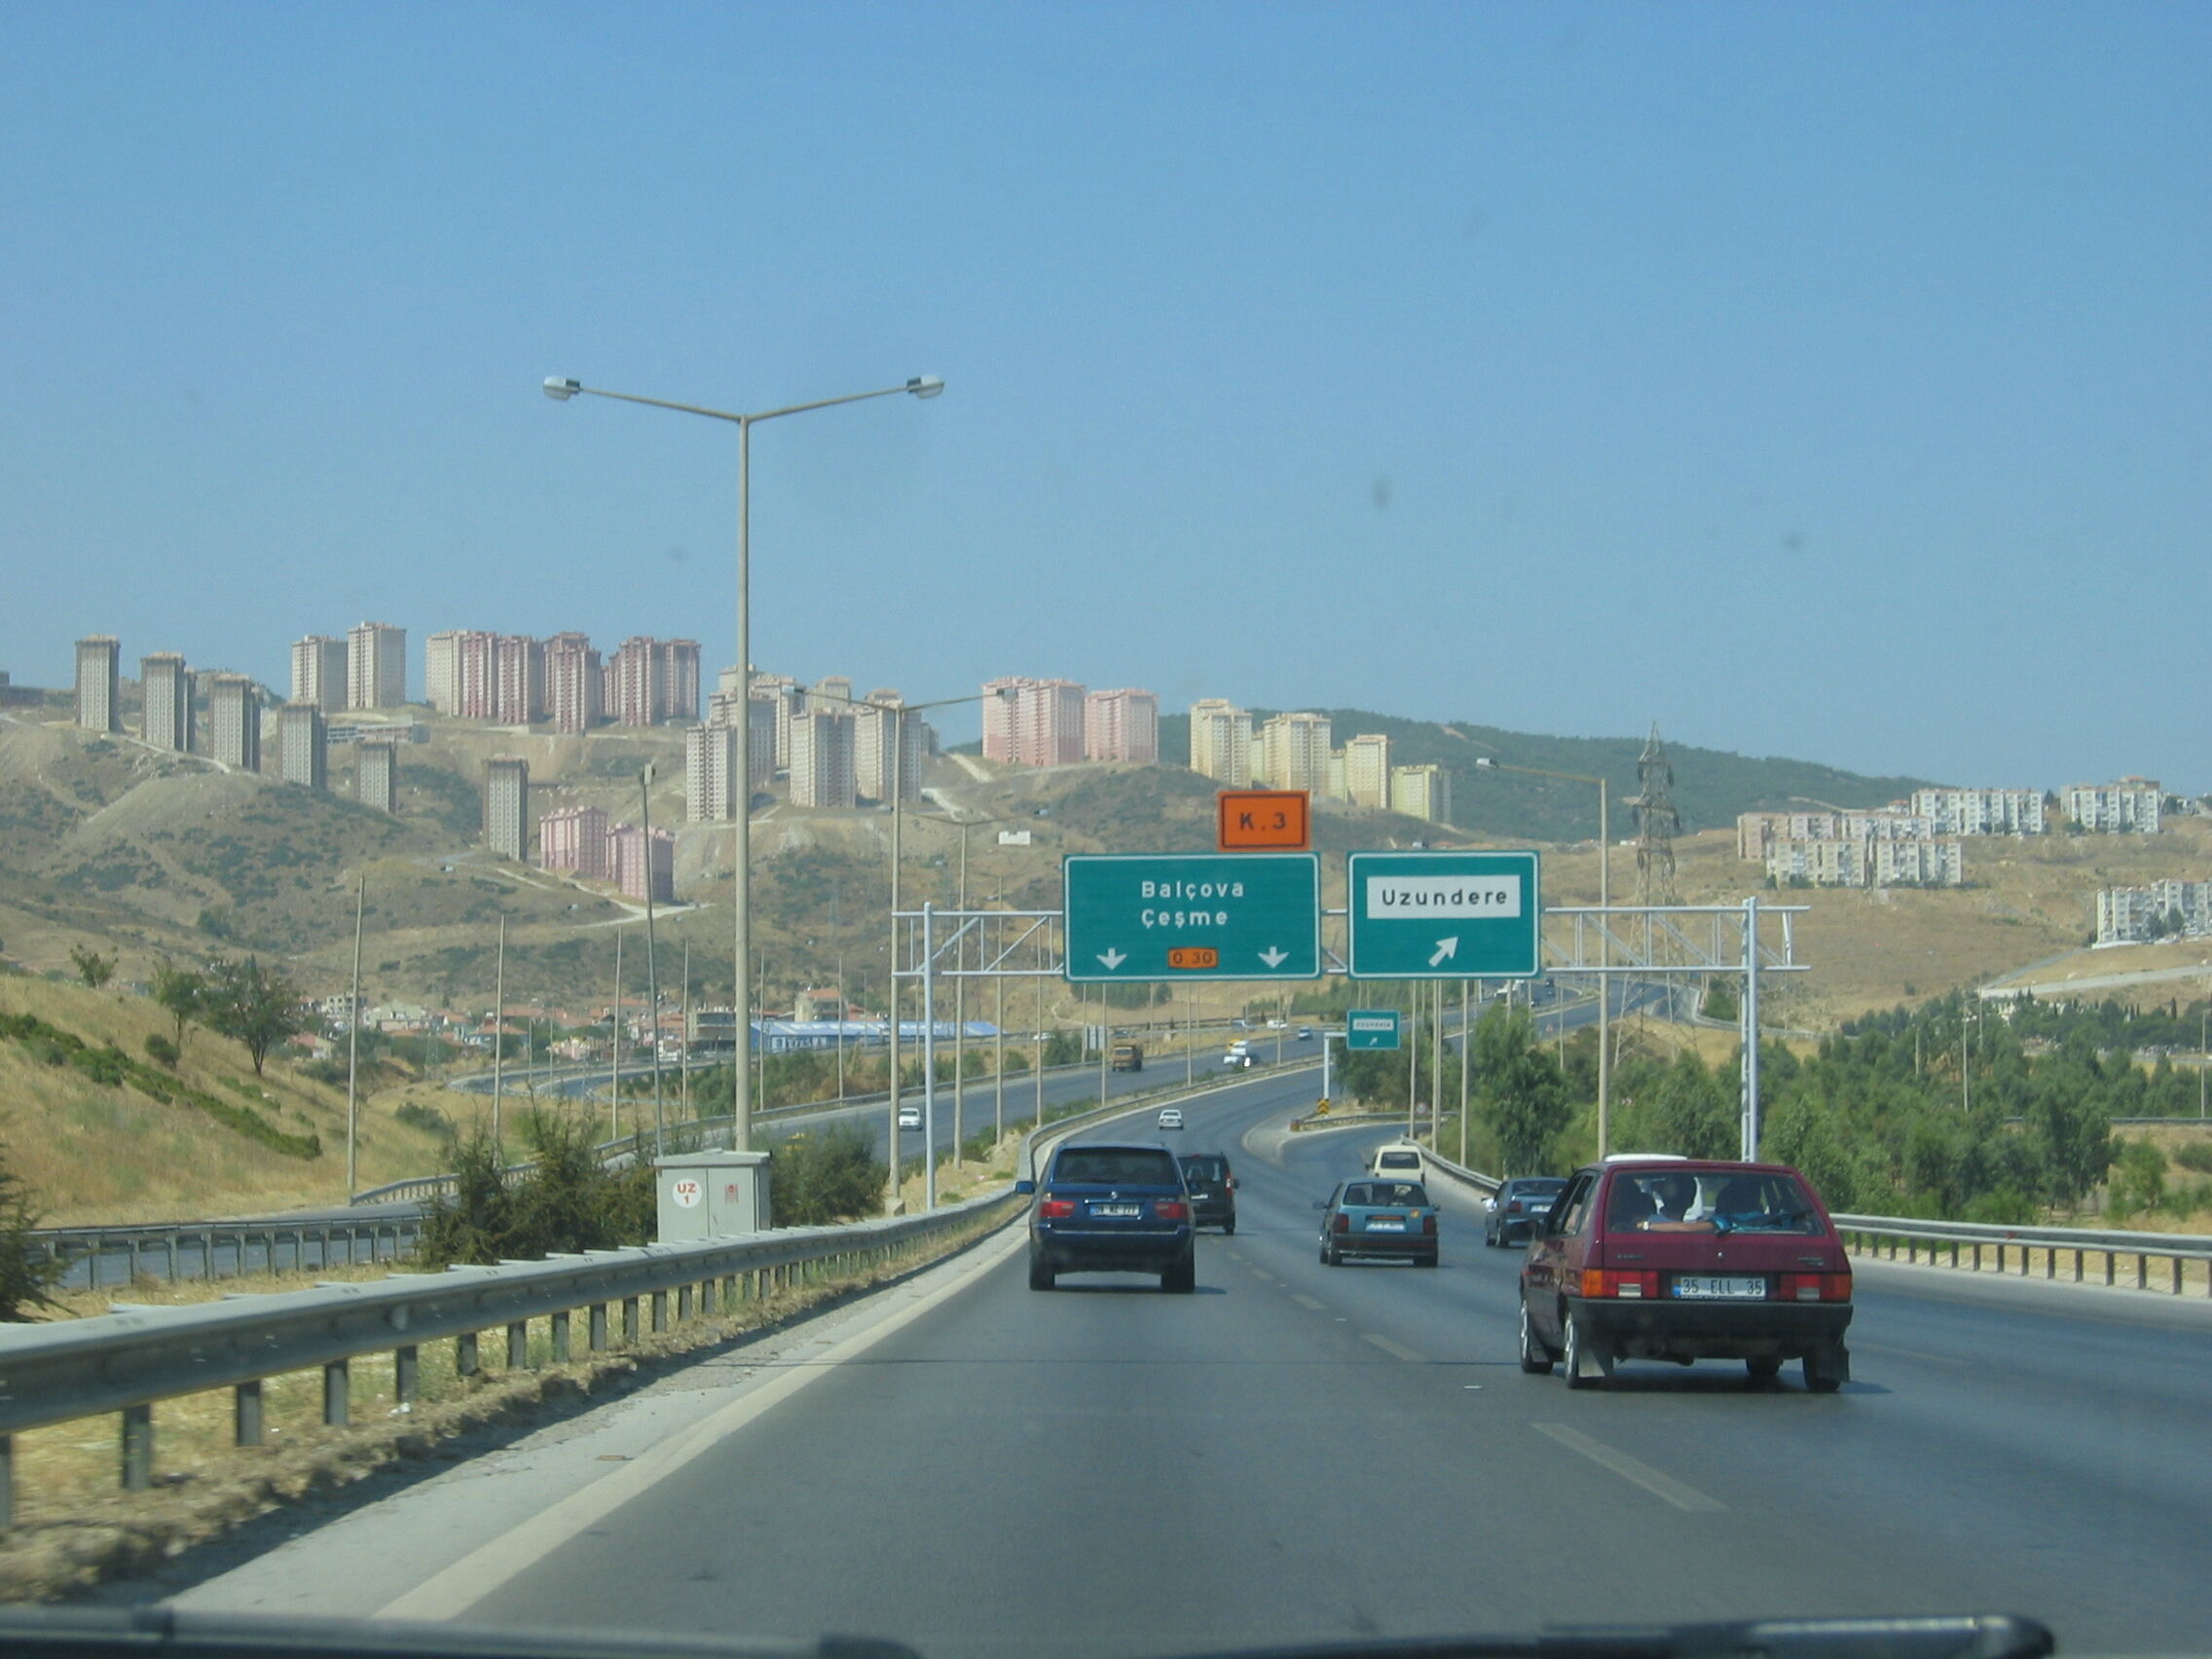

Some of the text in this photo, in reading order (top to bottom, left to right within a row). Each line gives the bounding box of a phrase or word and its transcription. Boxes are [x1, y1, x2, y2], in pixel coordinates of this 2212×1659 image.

[1141, 880, 1244, 902] Balçova
[1382, 888, 1507, 906] Uzundere
[1141, 908, 1229, 929] Çeşme
[677, 1183, 696, 1193] UZ
[1682, 1278, 1700, 1294] 35
[1746, 1280, 1763, 1295] 35
